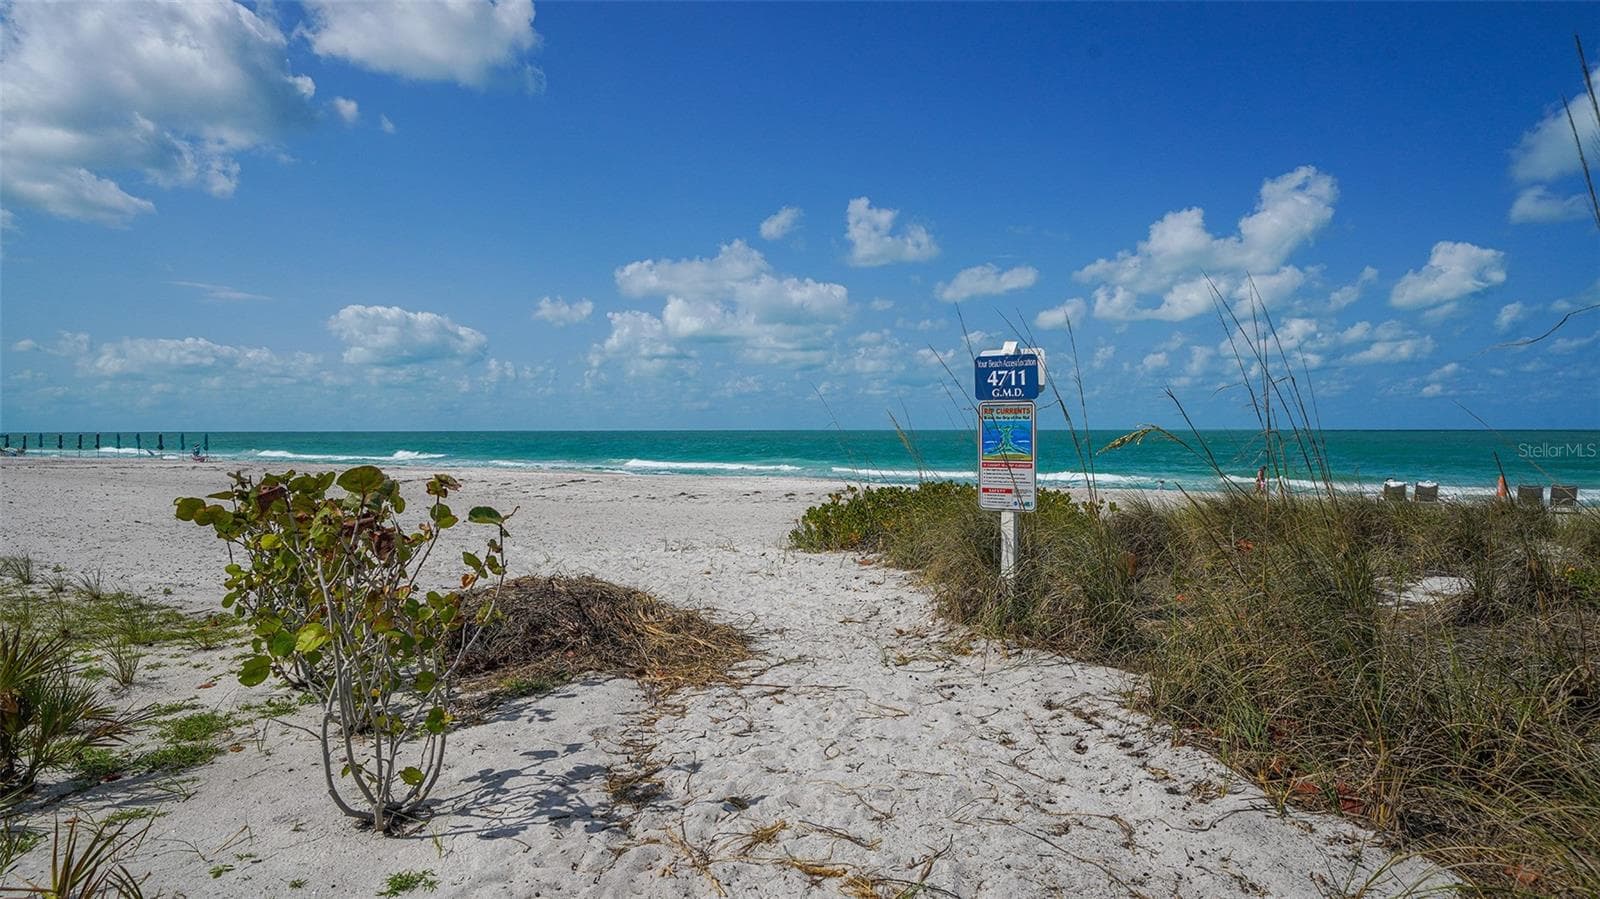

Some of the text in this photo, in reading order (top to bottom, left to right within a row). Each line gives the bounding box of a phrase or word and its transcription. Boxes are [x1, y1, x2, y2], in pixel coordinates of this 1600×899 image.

[977, 360, 987, 368] Your
[989, 359, 1002, 368] Beach
[987, 369, 1026, 386] 4711
[991, 388, 1025, 397] G.M.D.
[996, 407, 1031, 415] CURRENTS
